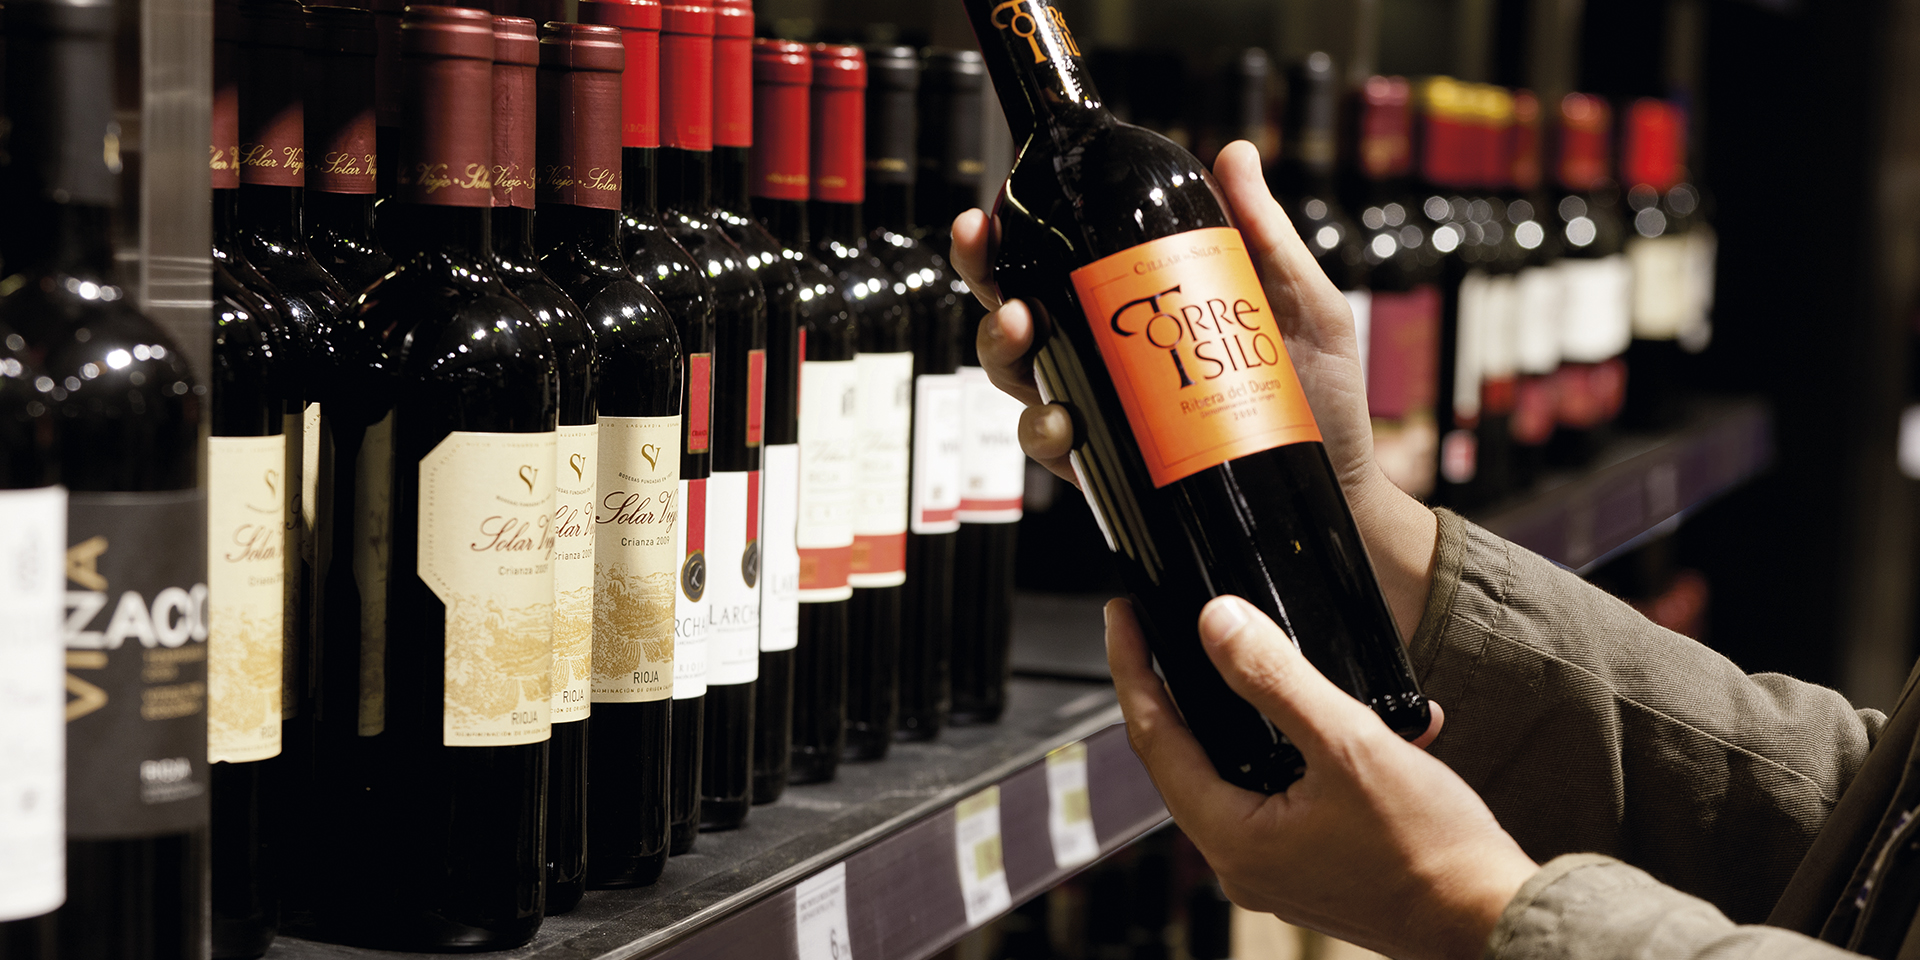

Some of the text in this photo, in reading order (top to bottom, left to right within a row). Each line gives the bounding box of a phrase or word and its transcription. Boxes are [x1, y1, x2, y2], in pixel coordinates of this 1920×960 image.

[239, 143, 278, 168] Solar
[320, 152, 360, 175] Solar
[460, 163, 491, 189] Sola
[583, 167, 617, 191] Solar
[1180, 378, 1282, 415] Ribera del Duero
[595, 491, 656, 525] Solar
[470, 515, 534, 552] Solar
[620, 535, 671, 548] Crianza 2009
[498, 566, 534, 577] Crianza
[709, 604, 760, 626] LARCH
[633, 670, 660, 684] RIOJA
[563, 689, 585, 703] RIOJA
[511, 711, 538, 725] RIOJA
